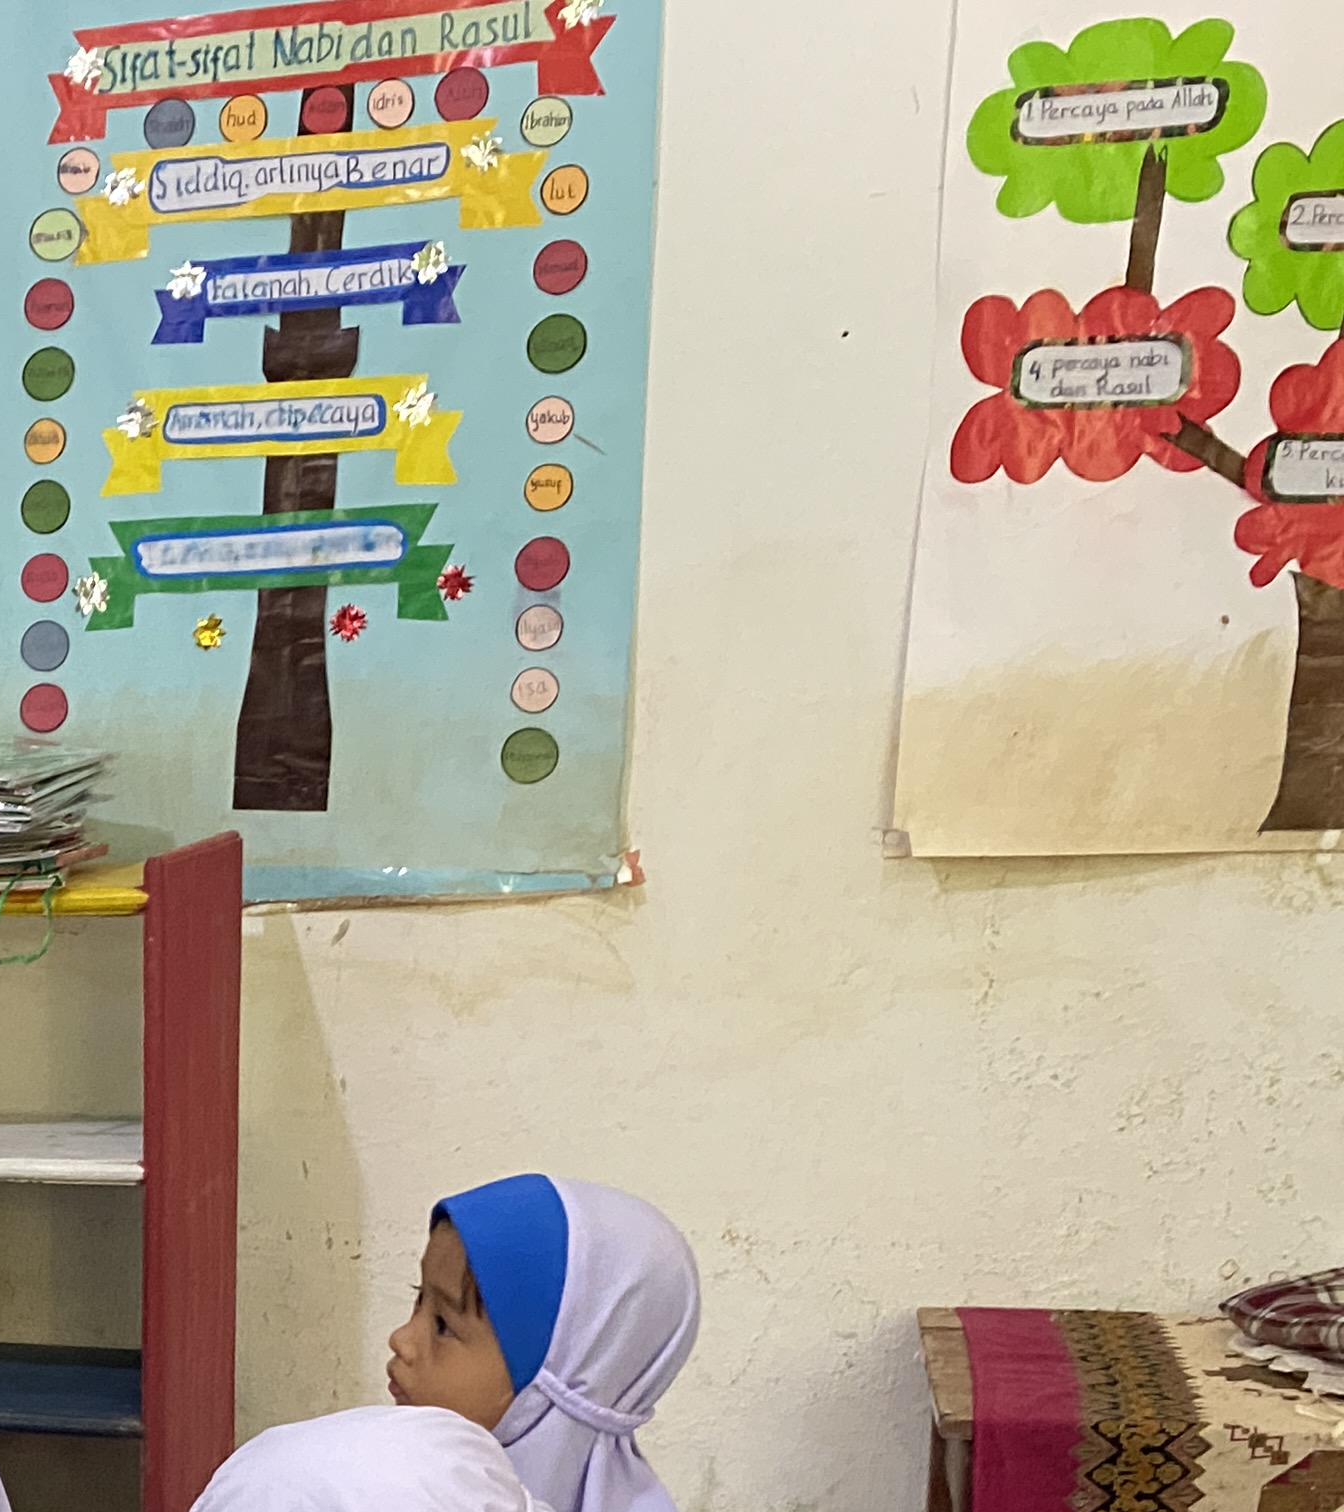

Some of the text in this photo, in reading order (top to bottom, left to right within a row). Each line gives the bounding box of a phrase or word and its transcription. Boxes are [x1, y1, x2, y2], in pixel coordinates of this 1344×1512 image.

[272, 23, 343, 69] Nabi
[350, 23, 417, 62] dan
[439, 1, 534, 52] Rasul
[226, 104, 257, 127] hud
[1041, 99, 1118, 125] Percaya
[1126, 98, 1165, 120] pada
[1171, 86, 1213, 110] Allah
[346, 154, 441, 184] Benar
[325, 260, 413, 294] Cerdik
[530, 408, 571, 432] yakub
